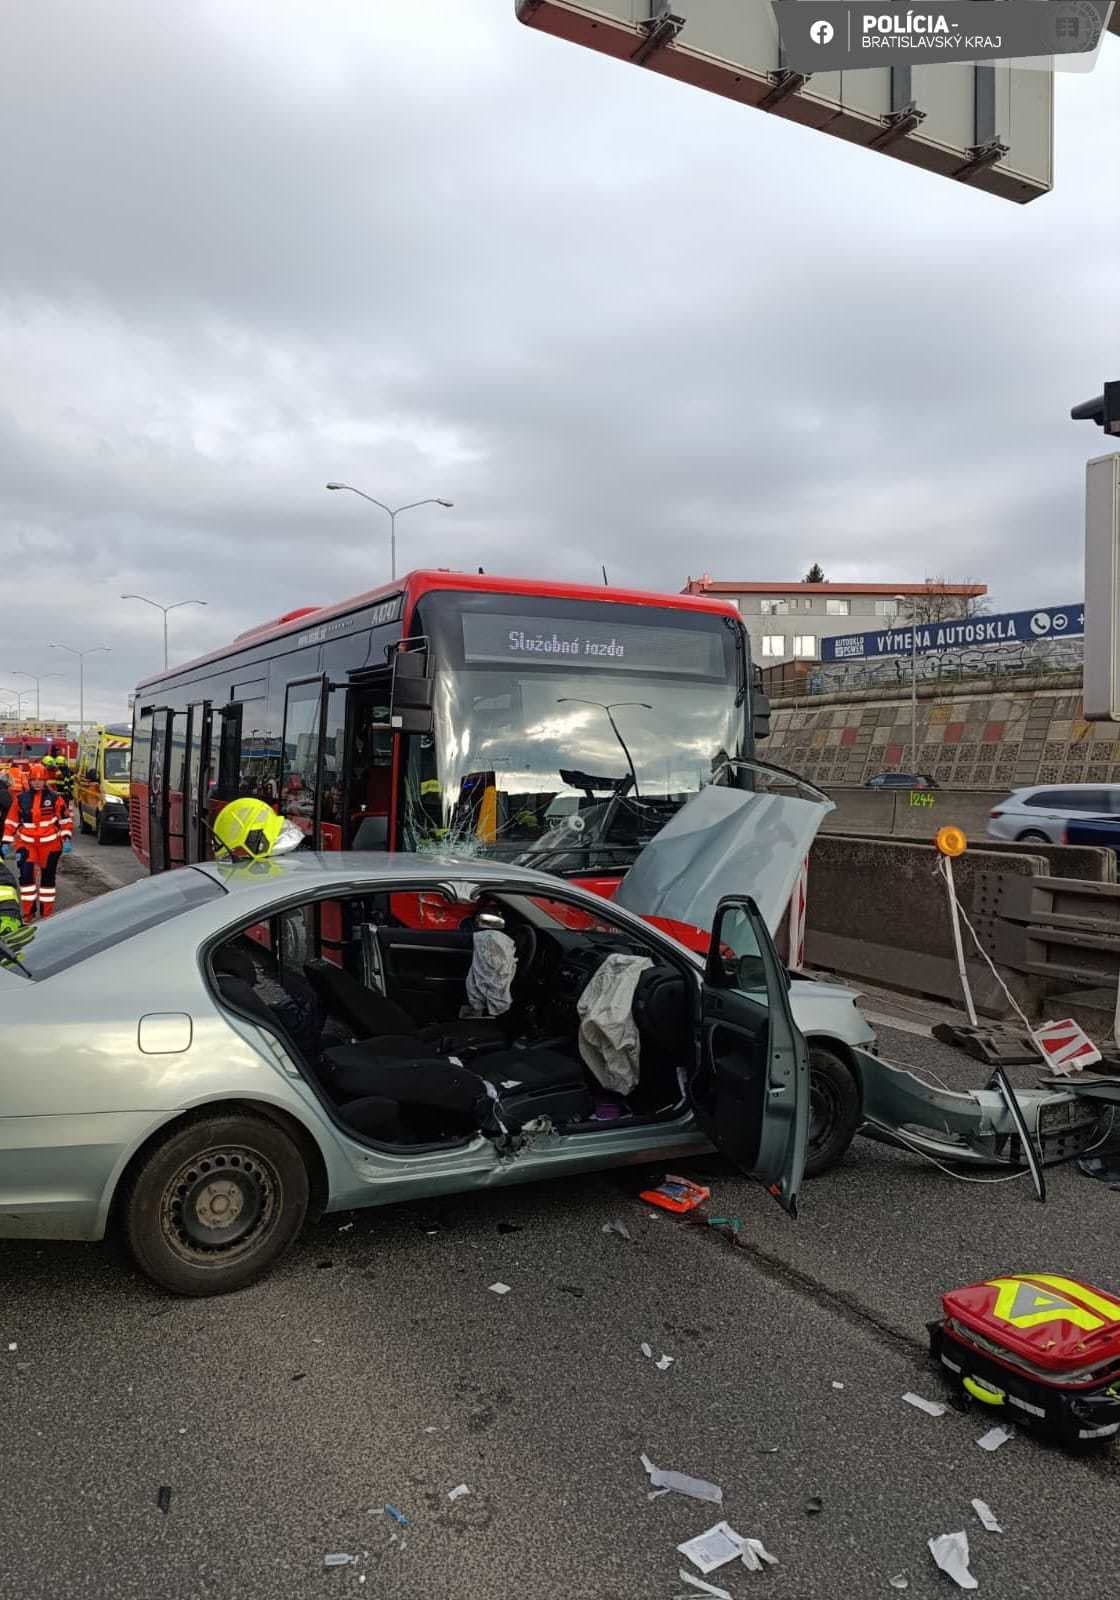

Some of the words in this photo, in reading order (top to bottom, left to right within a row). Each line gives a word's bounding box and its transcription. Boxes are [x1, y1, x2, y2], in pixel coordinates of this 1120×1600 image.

[584, 638, 625, 657] jazda
[876, 629, 931, 652] VÝMENA
[936, 619, 1017, 644] AUTOSKLA
